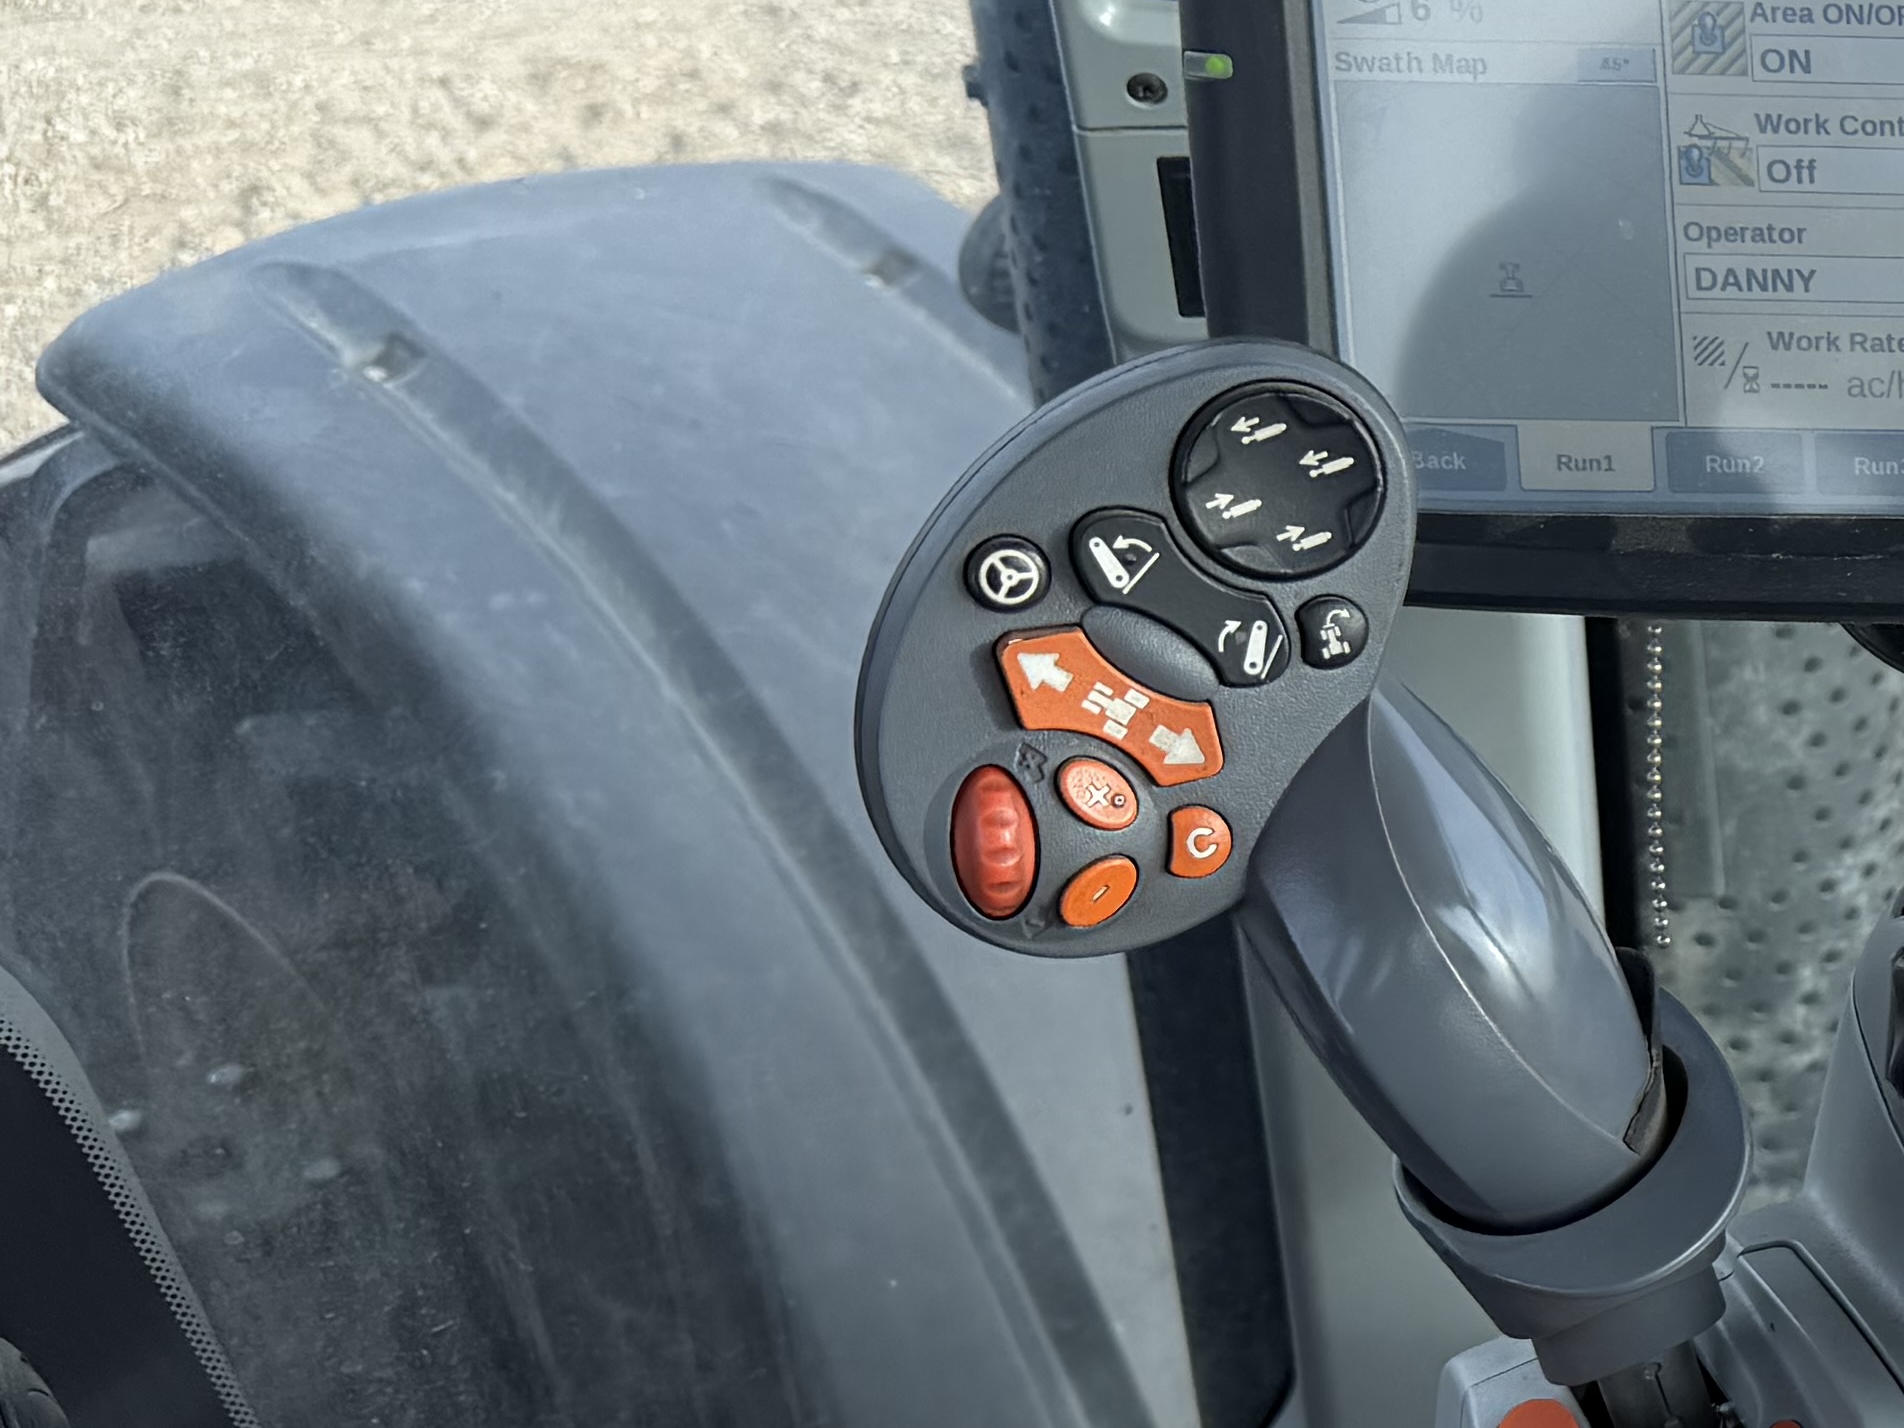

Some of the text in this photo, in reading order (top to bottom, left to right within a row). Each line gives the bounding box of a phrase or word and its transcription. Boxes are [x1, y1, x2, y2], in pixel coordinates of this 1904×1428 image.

[1750, 2, 1815, 24] Area
[1334, 51, 1488, 81] Swath Map
[1760, 48, 1812, 74] ON
[1754, 112, 1831, 136] Work
[1766, 158, 1817, 185] Off
[1683, 221, 1807, 249] Operator
[1694, 266, 1817, 293] DANNY
[1767, 330, 1841, 353] Work
[1556, 453, 1616, 473] Run1
[1706, 455, 1765, 475] Run2
